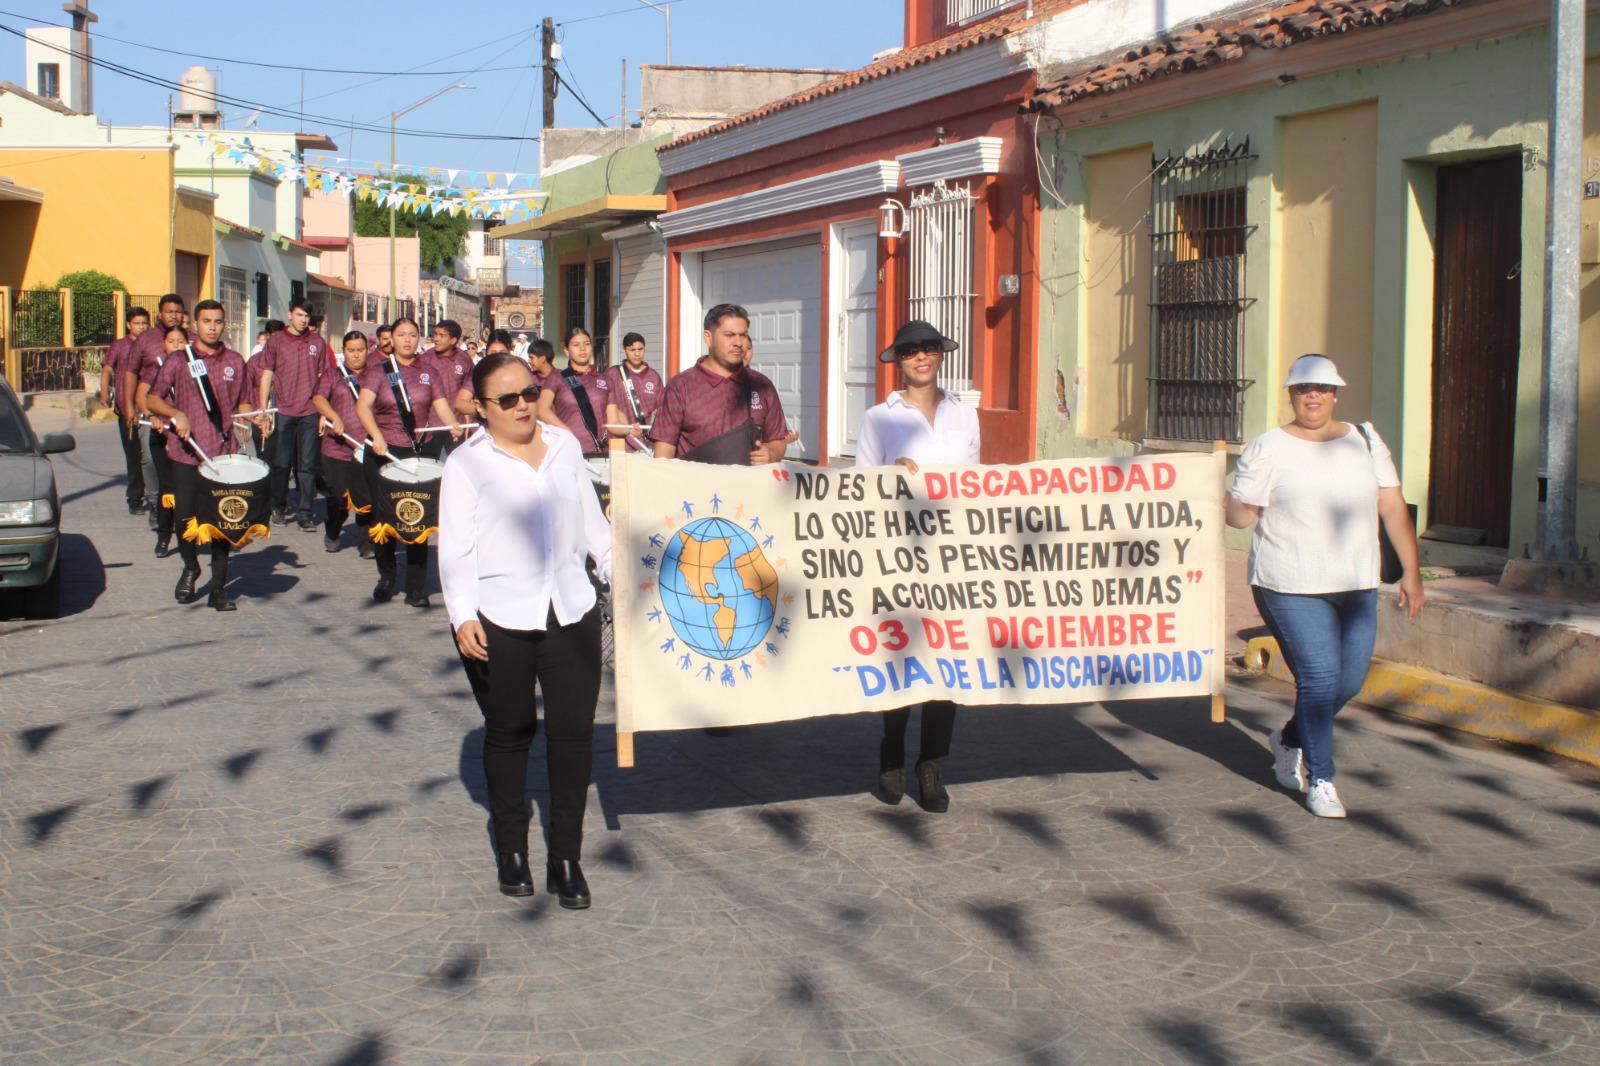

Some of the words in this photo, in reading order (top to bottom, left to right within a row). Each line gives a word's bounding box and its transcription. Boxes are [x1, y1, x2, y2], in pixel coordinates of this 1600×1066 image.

[838, 473, 865, 501] ES
[877, 474, 914, 500] LA
[924, 463, 1176, 500] DISCAPACIDAD
[794, 512, 824, 541] LO
[831, 510, 876, 543] QUE
[884, 509, 954, 538] HACE
[966, 505, 1069, 535] DIFICIL
[1081, 503, 1116, 532] LA
[1125, 500, 1202, 532] VIDA,
[802, 548, 864, 580] SINO
[876, 546, 930, 576] LOS
[939, 539, 1161, 574] PENSAMIENTOS
[1173, 538, 1191, 565] Y
[805, 588, 854, 619] LAS
[872, 579, 998, 615] ACCIONES
[1004, 579, 1036, 608] DE
[1043, 579, 1083, 607] LOS
[849, 619, 909, 656] 03
[922, 617, 969, 650] DE
[986, 612, 1176, 649] DICIEMBRE
[936, 657, 972, 690] DE
[977, 657, 1016, 689] LA
